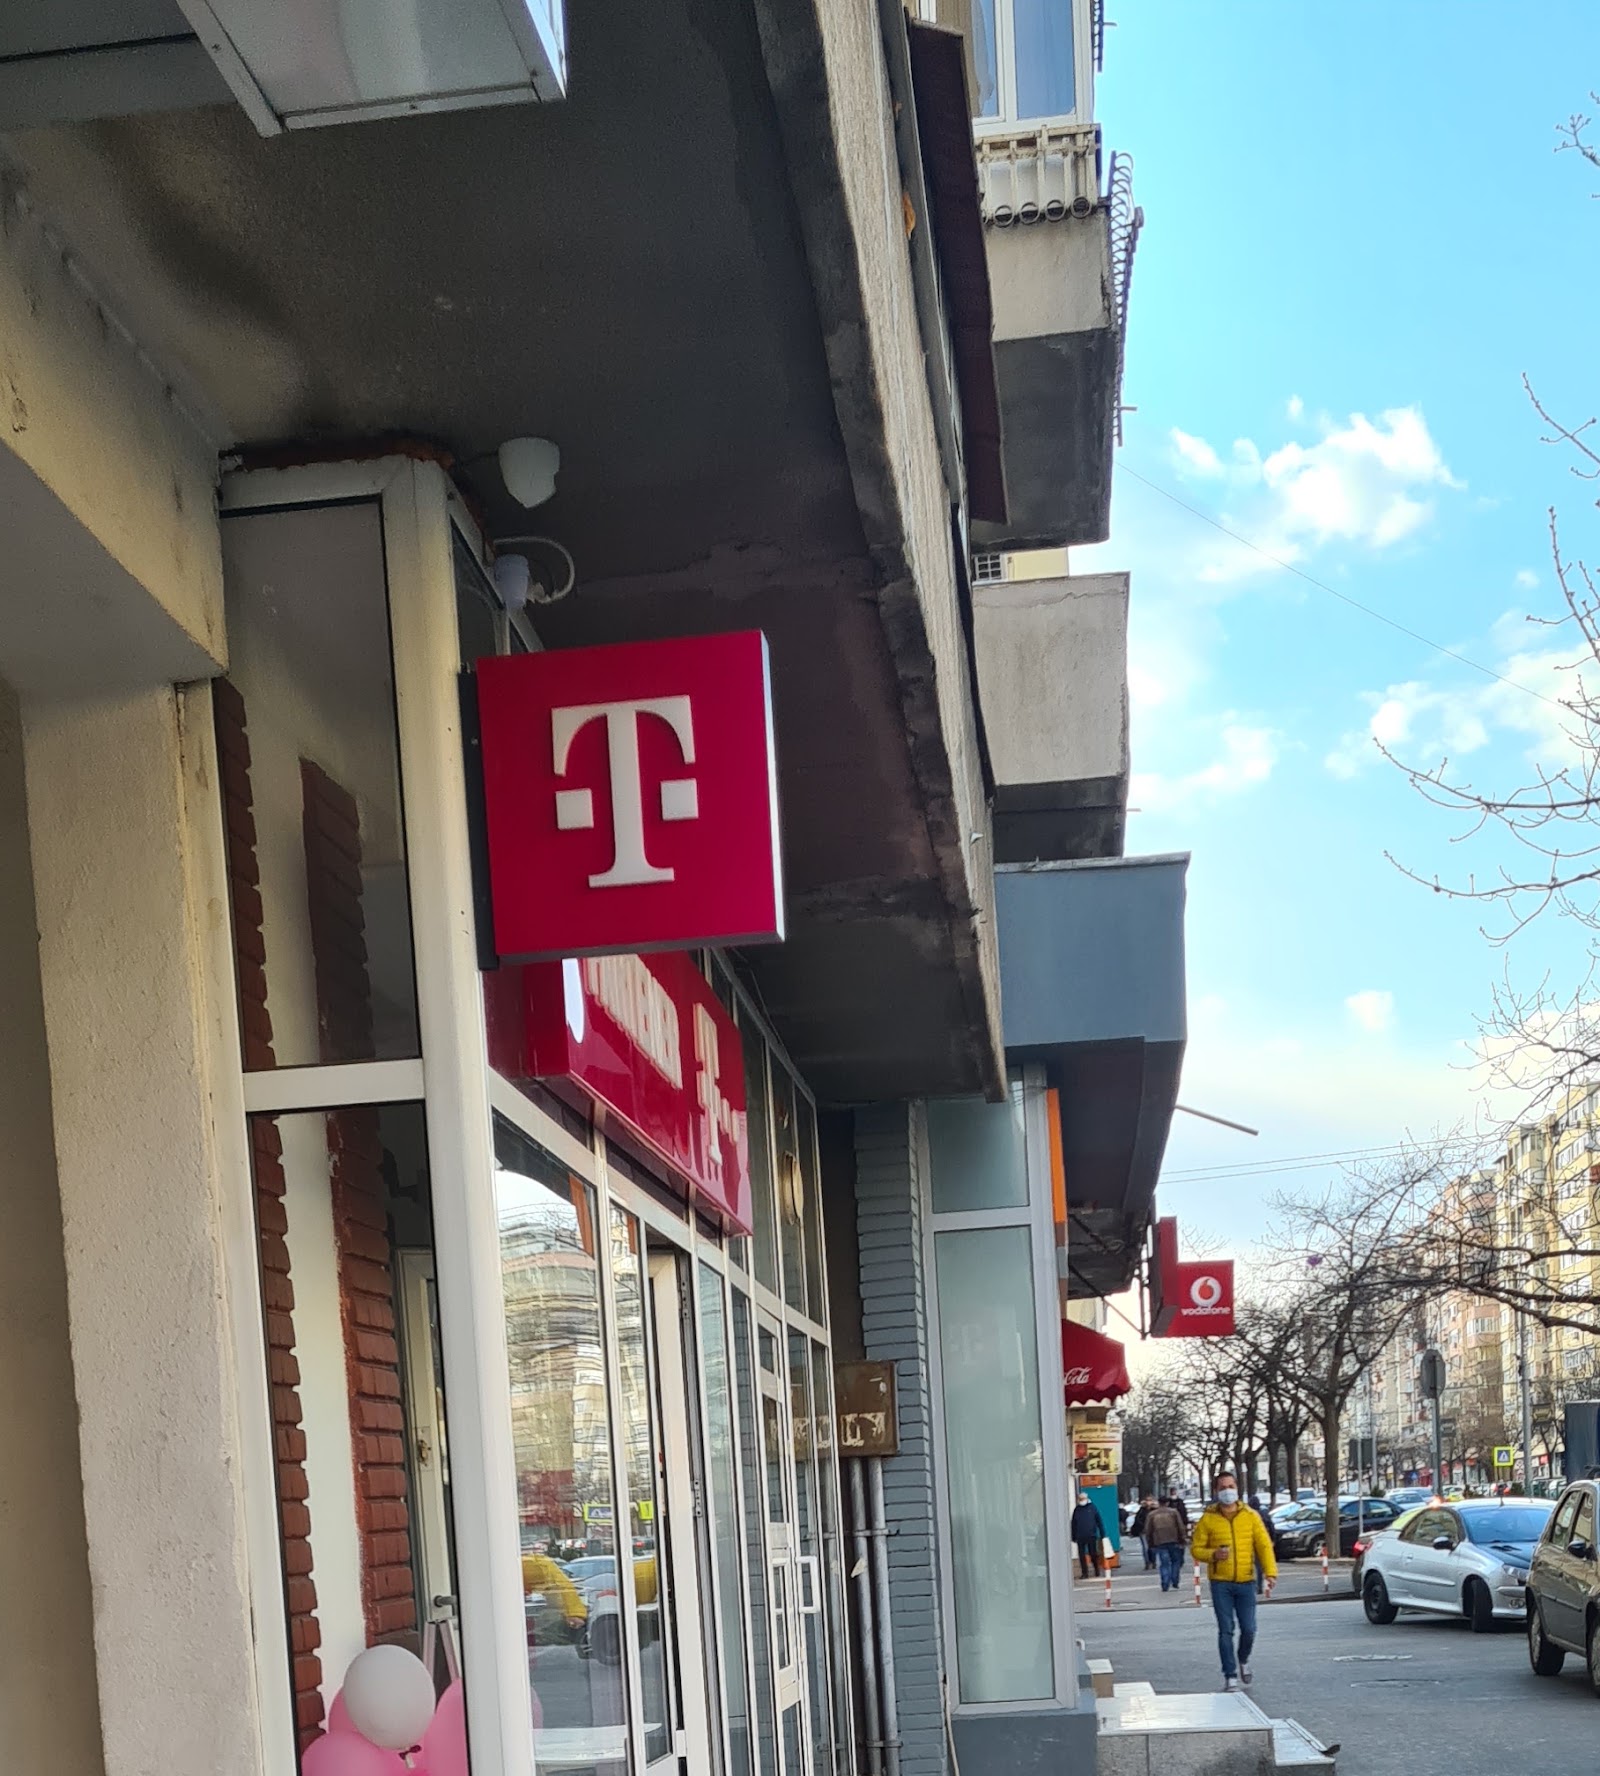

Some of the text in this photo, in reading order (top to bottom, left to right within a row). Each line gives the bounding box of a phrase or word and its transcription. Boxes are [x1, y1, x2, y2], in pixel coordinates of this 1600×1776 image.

[551, 694, 698, 888] T
[1181, 1306, 1231, 1316] vodafone
[1064, 1367, 1093, 1386] Cola
